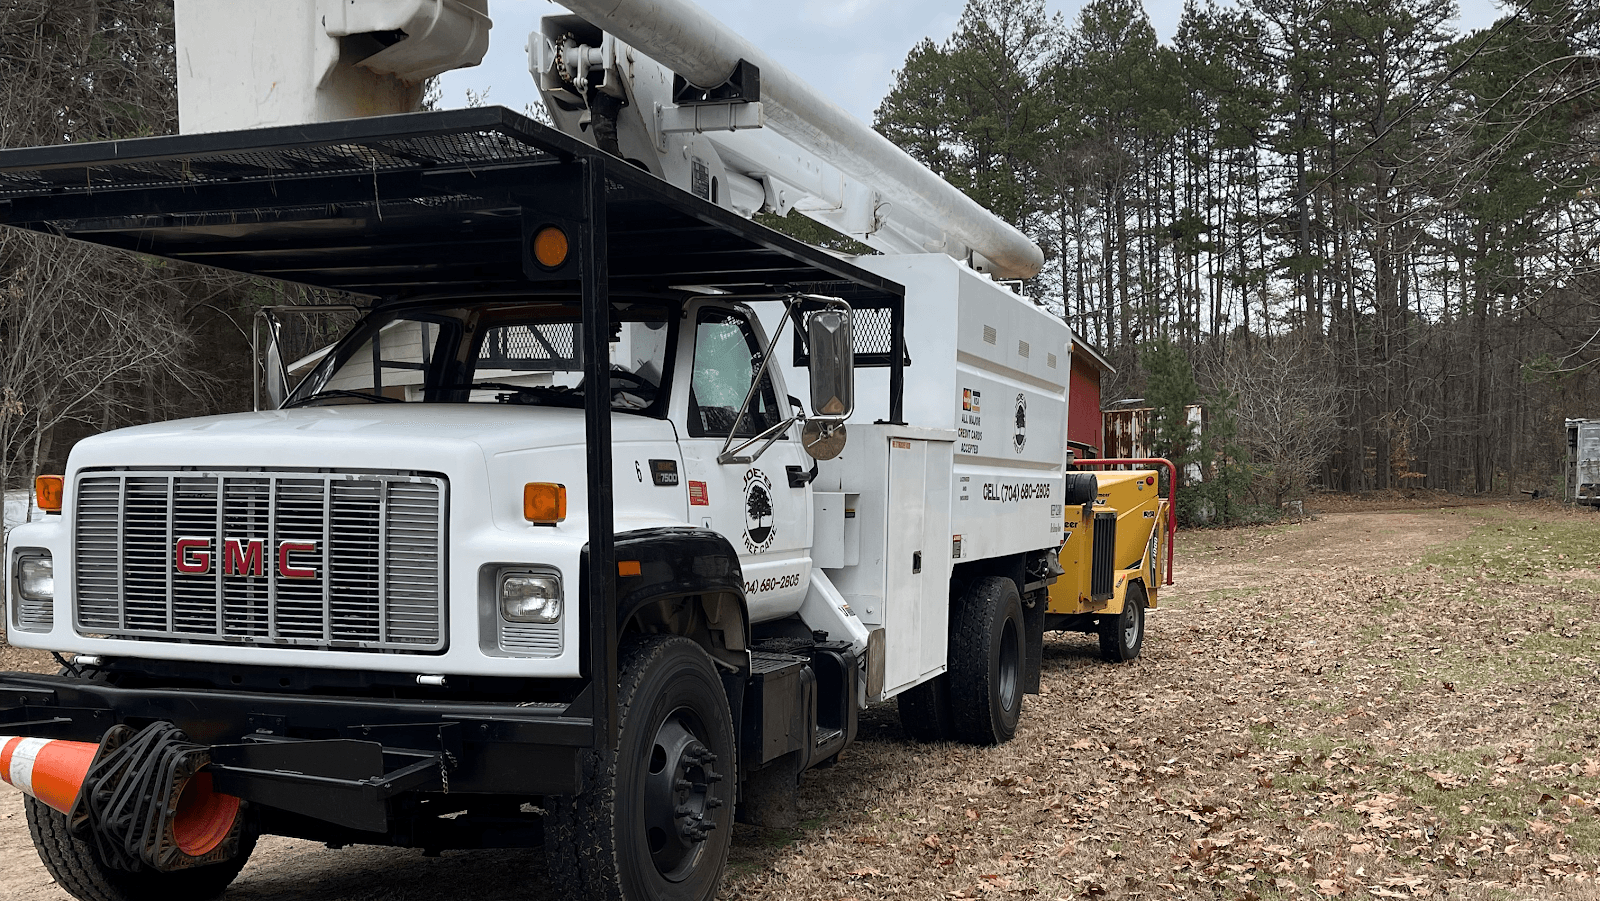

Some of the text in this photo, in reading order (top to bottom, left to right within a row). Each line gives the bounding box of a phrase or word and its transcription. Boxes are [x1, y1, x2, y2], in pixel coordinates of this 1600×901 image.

[969, 415, 981, 427] MAJOR
[958, 427, 982, 441] CREDIT CARDS
[961, 443, 978, 454] ACCEPTED
[983, 483, 1050, 502] CELL (704) 680-2805
[1064, 521, 1078, 529] eer
[176, 536, 318, 580] GMC
[744, 573, 800, 595] 04) 680-2805
